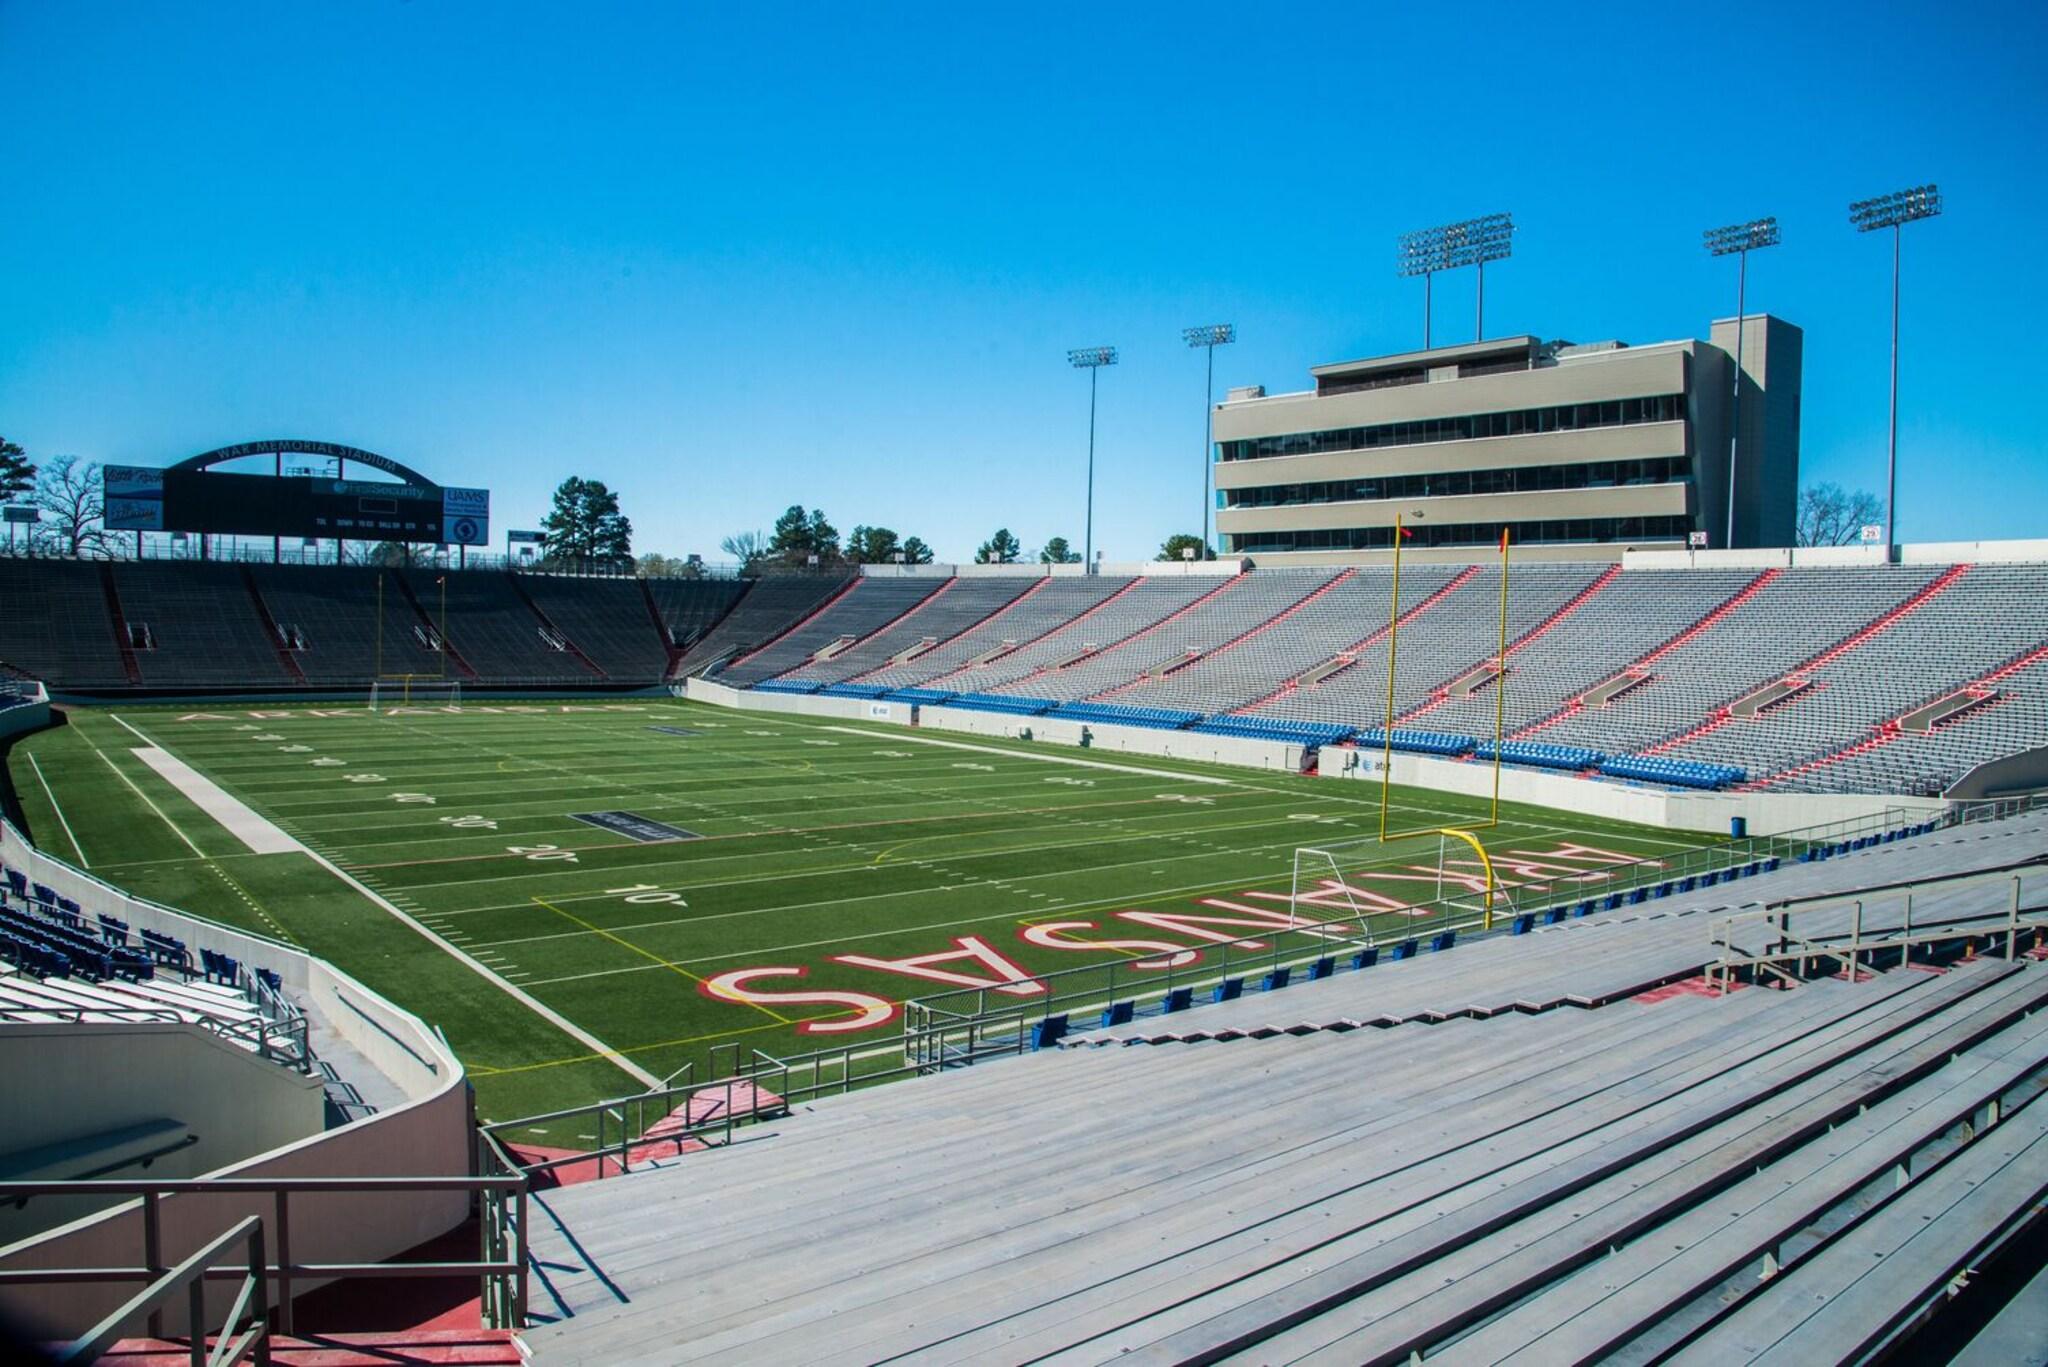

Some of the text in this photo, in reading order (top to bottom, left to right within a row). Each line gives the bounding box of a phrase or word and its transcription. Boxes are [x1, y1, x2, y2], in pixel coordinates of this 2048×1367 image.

[216, 440, 396, 472] WAR MEMORIAL STADIUM
[447, 489, 485, 503] UAMS
[605, 883, 682, 905] 10
[699, 842, 1670, 1034] ARKANSAS
